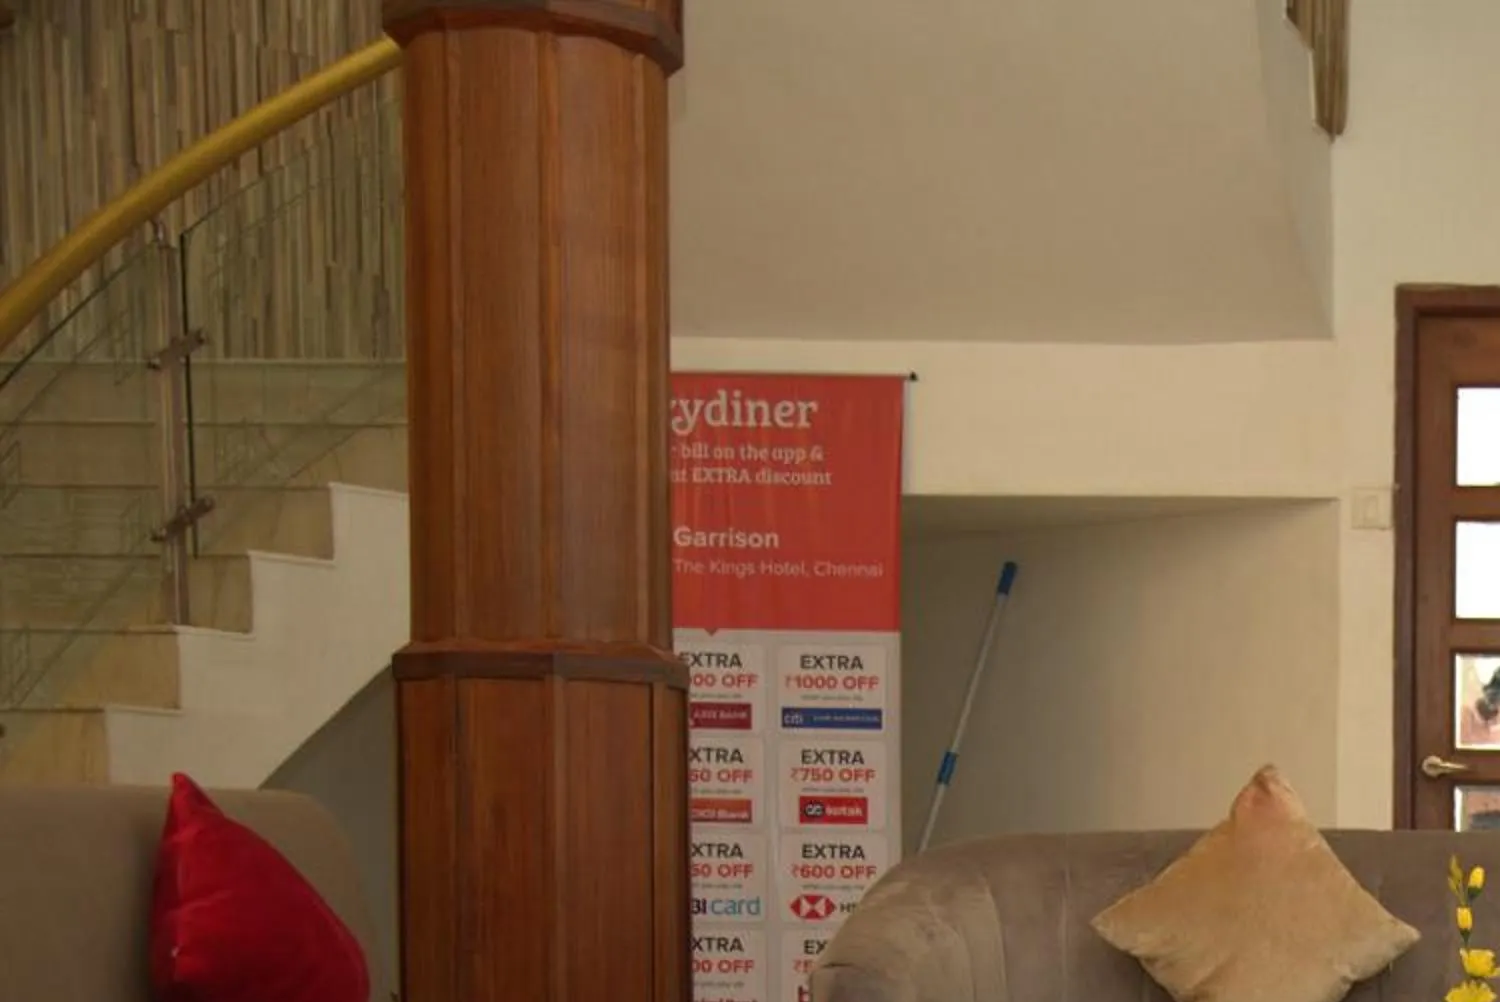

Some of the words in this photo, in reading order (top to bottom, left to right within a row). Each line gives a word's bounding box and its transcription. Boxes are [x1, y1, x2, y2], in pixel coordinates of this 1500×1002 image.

[671, 389, 818, 436] ydiner
[681, 443, 709, 460] bill
[713, 447, 735, 460] on
[739, 446, 768, 462] the
[771, 447, 806, 464] app
[692, 467, 751, 484] EXTRA
[755, 469, 832, 486] discount
[672, 525, 780, 549] Garrison
[672, 558, 705, 574] The
[709, 560, 755, 578] Kings
[813, 561, 883, 578] Chennai
[800, 655, 863, 670] EXTRA
[691, 673, 716, 688] 00
[721, 673, 758, 689] OFF
[843, 675, 879, 690] OFF
[689, 747, 744, 763] XTRA
[801, 749, 864, 764] EXTRA
[717, 769, 753, 784] OFF
[839, 768, 876, 783] OFF
[690, 843, 743, 859] XTRA
[802, 843, 866, 859] EXTRA
[690, 863, 712, 878] 50
[718, 863, 753, 879] OFF
[840, 864, 877, 879] OFF
[690, 897, 707, 915] BI
[711, 895, 761, 915] card
[690, 937, 744, 952] XTRA
[691, 959, 712, 973] 00
[718, 960, 754, 973] OFF
